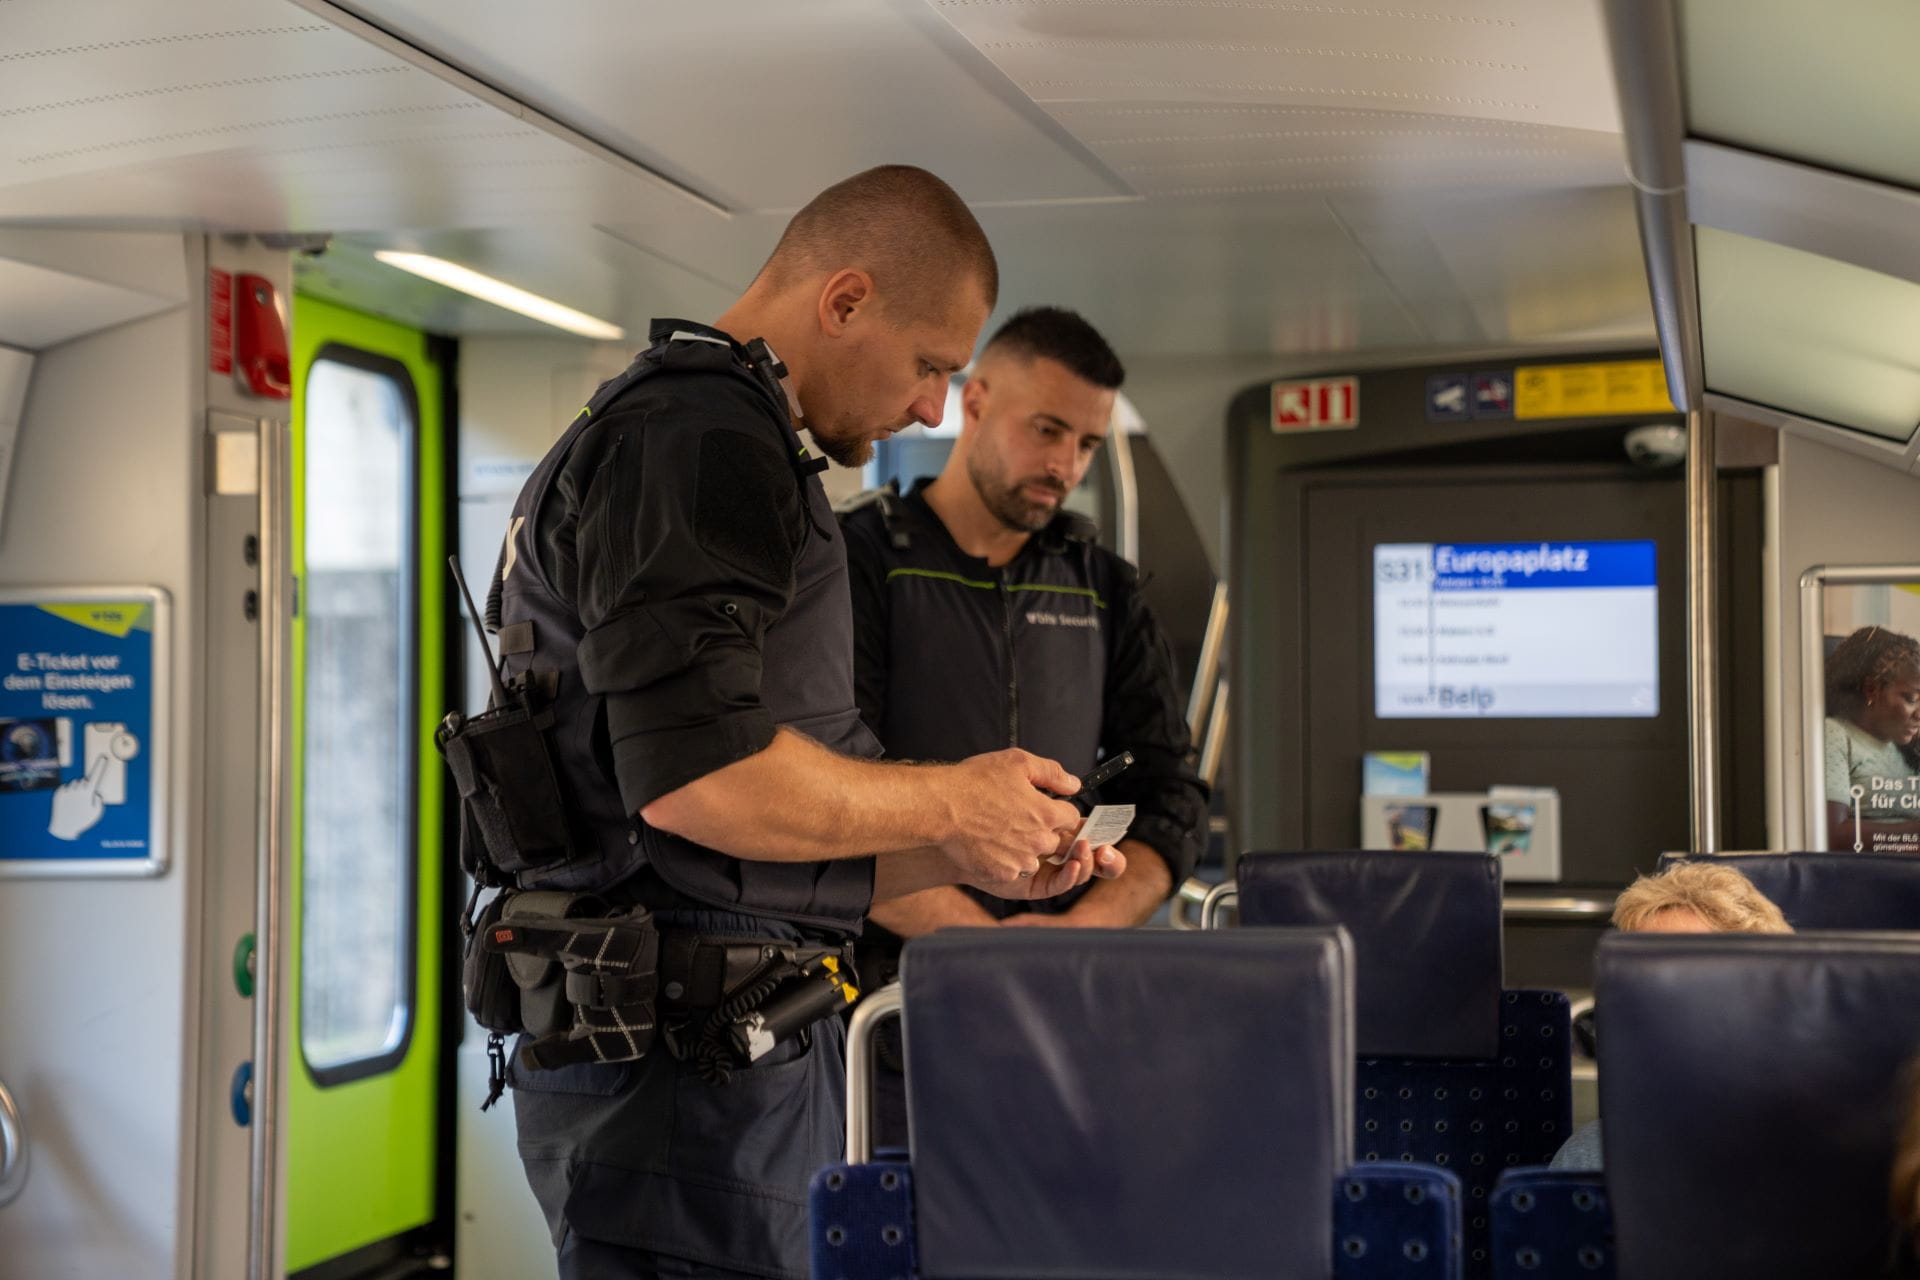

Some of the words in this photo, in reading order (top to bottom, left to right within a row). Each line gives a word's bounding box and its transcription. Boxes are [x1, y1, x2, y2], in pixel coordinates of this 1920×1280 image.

[1435, 544, 1589, 576] Europaplatz
[17, 653, 87, 670] E-Ticket
[91, 655, 119, 669] vor
[4, 675, 41, 690] dem
[44, 673, 133, 692] Einsteigen
[1438, 686, 1495, 714] Belp
[1871, 776, 1904, 791] Das
[1907, 776, 1920, 791] T
[1871, 793, 1897, 809] für
[1873, 833, 1886, 842] Mit
[1887, 833, 1901, 842] der
[1902, 833, 1918, 842] BLS
